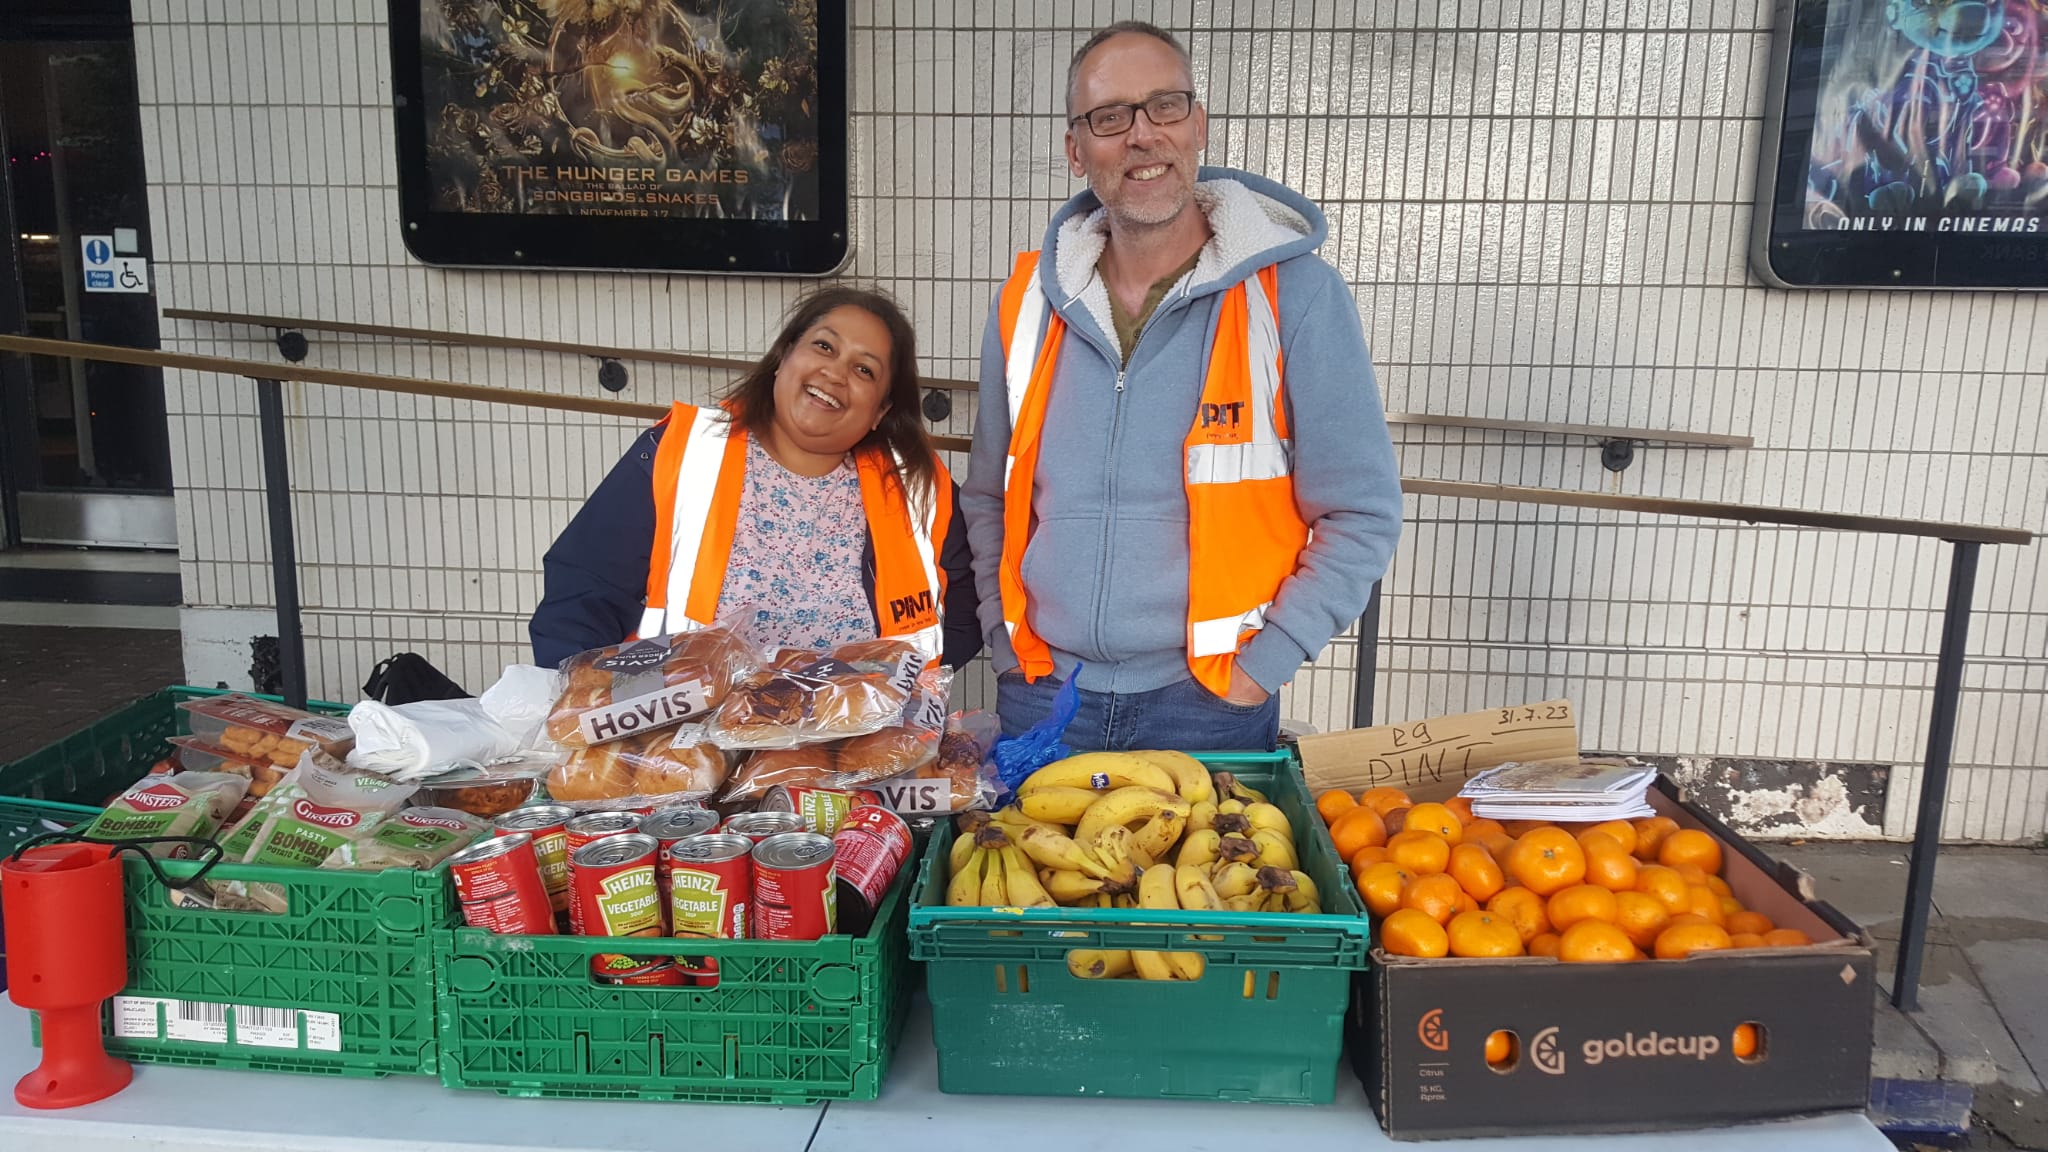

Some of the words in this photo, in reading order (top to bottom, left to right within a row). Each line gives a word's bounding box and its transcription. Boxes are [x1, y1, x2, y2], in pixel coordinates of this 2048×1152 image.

[503, 165, 549, 180] THE
[557, 166, 656, 182] HUNGER
[665, 168, 749, 184] GAMES
[533, 190, 637, 203] SONGBIRDS
[646, 192, 720, 205] SNAKES
[580, 208, 648, 217] NOVEMBER
[654, 209, 669, 218] 17
[1837, 216, 1894, 231] ONLY
[1904, 217, 1927, 231] IN
[1937, 217, 2040, 232] CINEMAS
[90, 271, 110, 280] Keep
[889, 590, 933, 624] PINT
[1498, 705, 1568, 724] 31.7.23
[1368, 741, 1494, 788] PINT
[357, 777, 389, 788] VEGAN
[877, 785, 938, 810] VIS
[296, 799, 357, 826] GINSTERS
[804, 796, 817, 833] HEINZ
[100, 817, 169, 831] BOMBAY
[295, 827, 327, 842] PASTY
[266, 845, 293, 858] POTATO
[536, 837, 567, 857] HEIN
[610, 872, 653, 895] HEINZ
[674, 874, 712, 892] HEINZ
[607, 889, 659, 915] VEGETABLE
[1582, 1031, 1720, 1064] goldcup
[1419, 1069, 1445, 1077] Citrus
